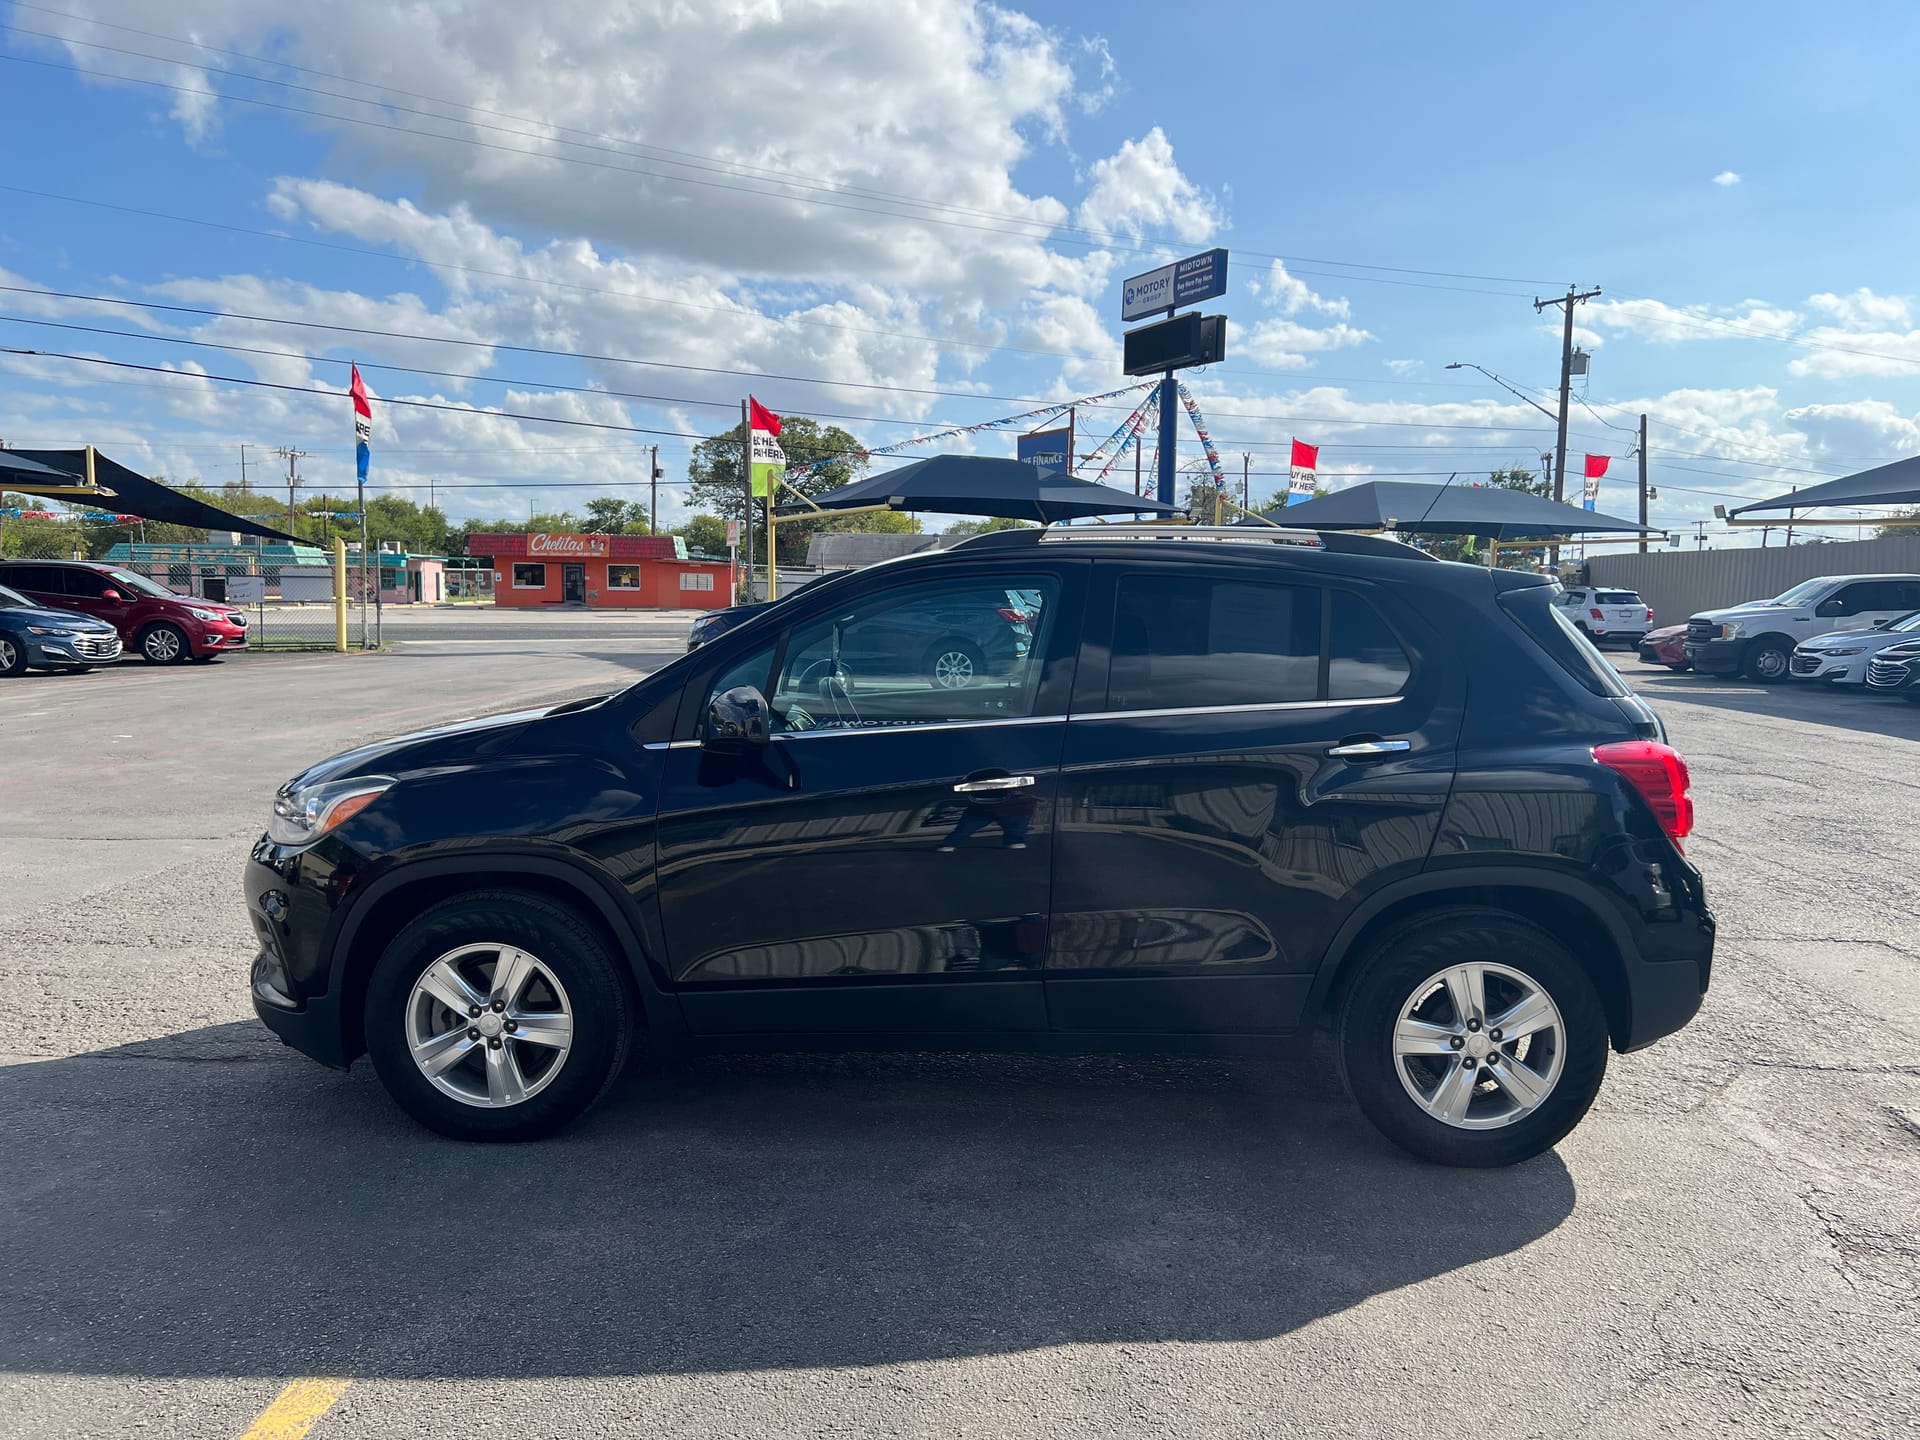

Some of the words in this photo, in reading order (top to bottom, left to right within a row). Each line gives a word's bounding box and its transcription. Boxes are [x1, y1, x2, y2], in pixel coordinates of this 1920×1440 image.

[1179, 255, 1213, 273] MIDTOWN
[1136, 277, 1170, 297] MOTORY
[1142, 293, 1162, 304] GROUP
[1032, 453, 1063, 466] FINANCE
[531, 533, 584, 552] Chelitas
